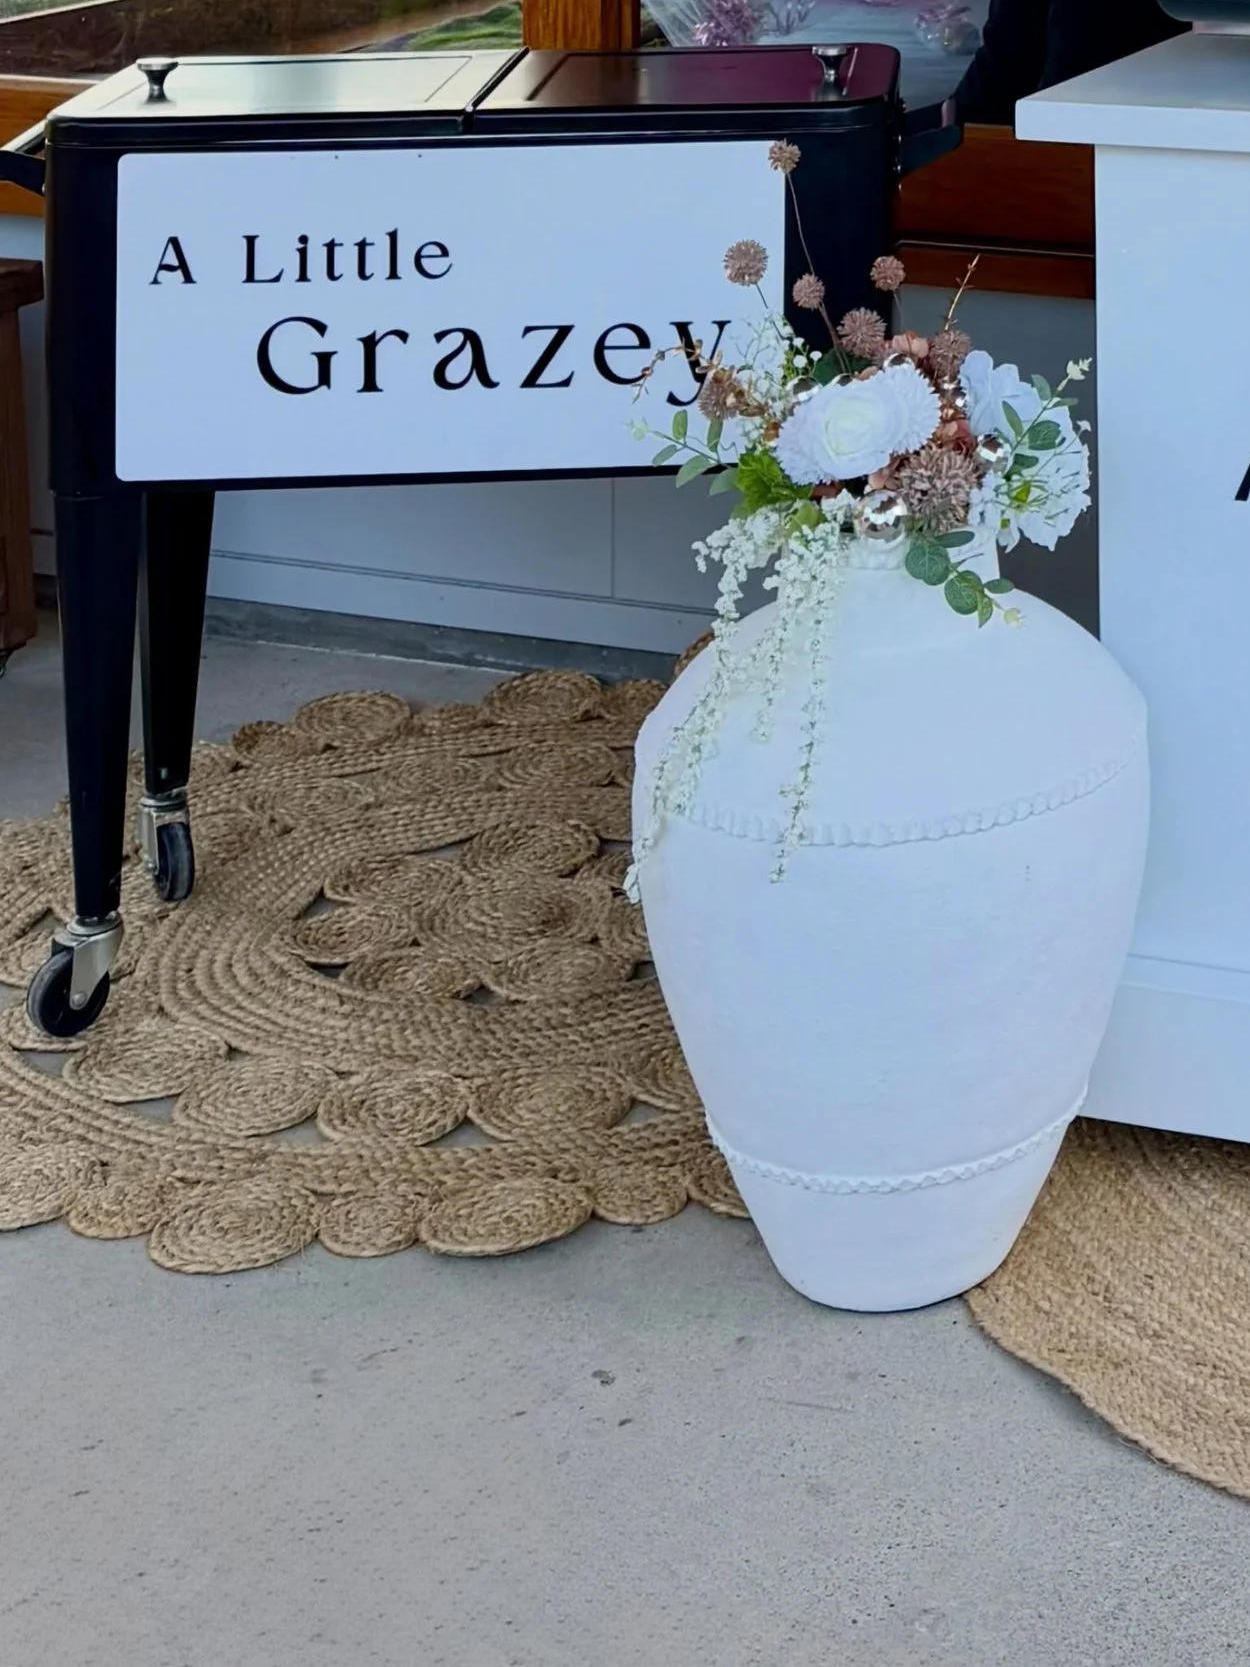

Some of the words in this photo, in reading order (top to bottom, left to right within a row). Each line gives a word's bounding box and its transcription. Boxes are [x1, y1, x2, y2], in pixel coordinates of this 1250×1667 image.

[149, 236, 197, 285] A
[242, 228, 453, 284] Little
[256, 316, 732, 407] Grazey
